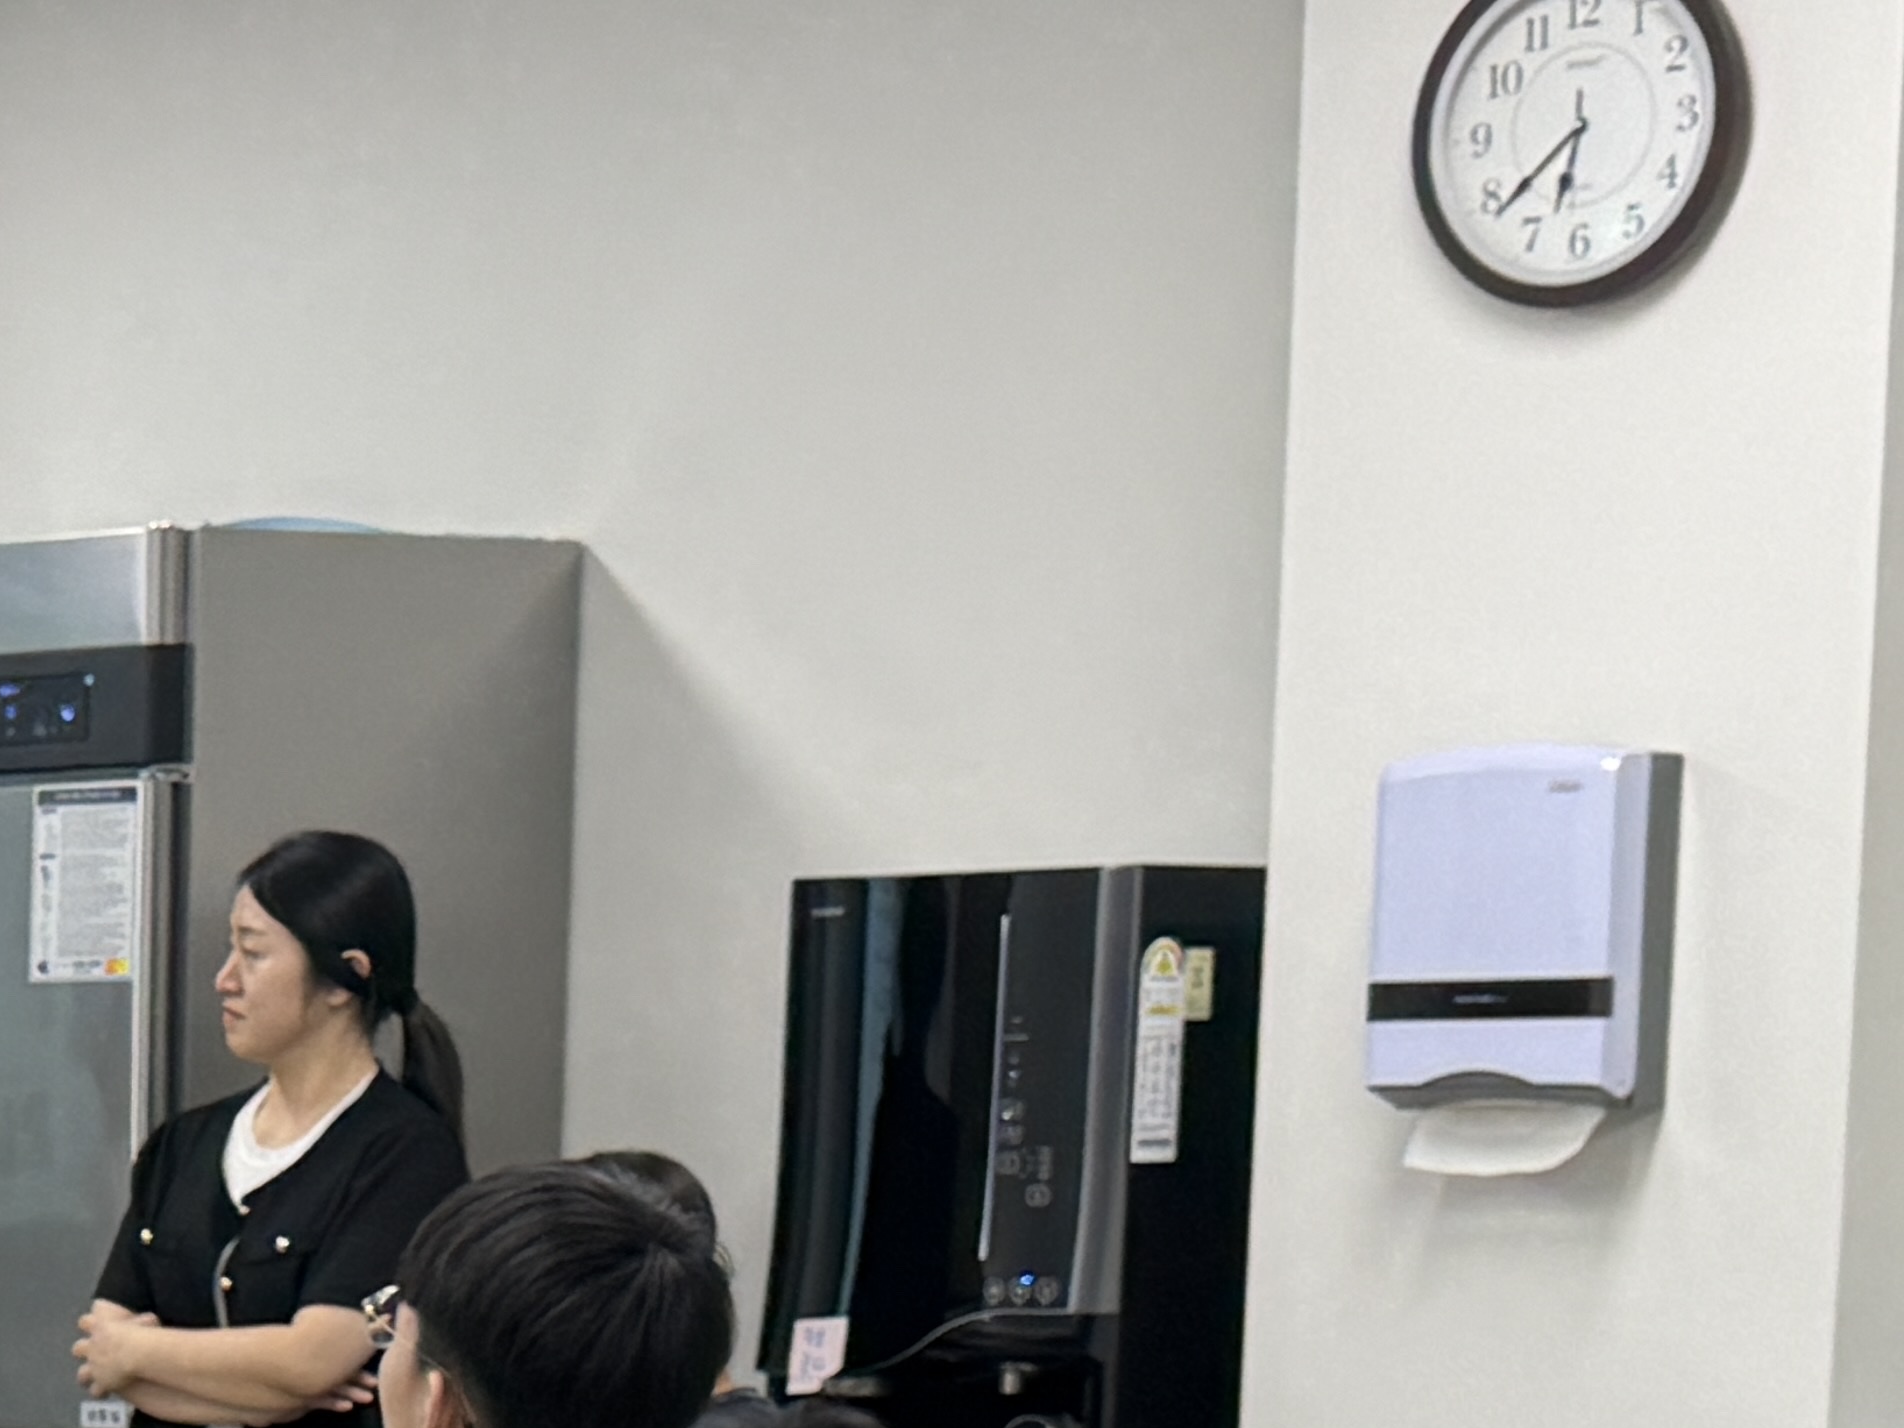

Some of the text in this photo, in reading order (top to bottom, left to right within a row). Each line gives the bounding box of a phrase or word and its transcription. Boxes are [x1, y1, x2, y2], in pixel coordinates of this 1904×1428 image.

[1524, 15, 1550, 53] 11
[1567, 0, 1603, 31] 12
[1664, 34, 1690, 73] 2
[1487, 60, 1525, 100] 10
[1675, 94, 1701, 133] 3
[1470, 123, 1493, 159] 9
[1656, 153, 1679, 191] 4
[1481, 179, 1504, 216] 8
[1521, 217, 1544, 254] 7
[1567, 222, 1591, 259] 6
[1622, 203, 1646, 241] 5
